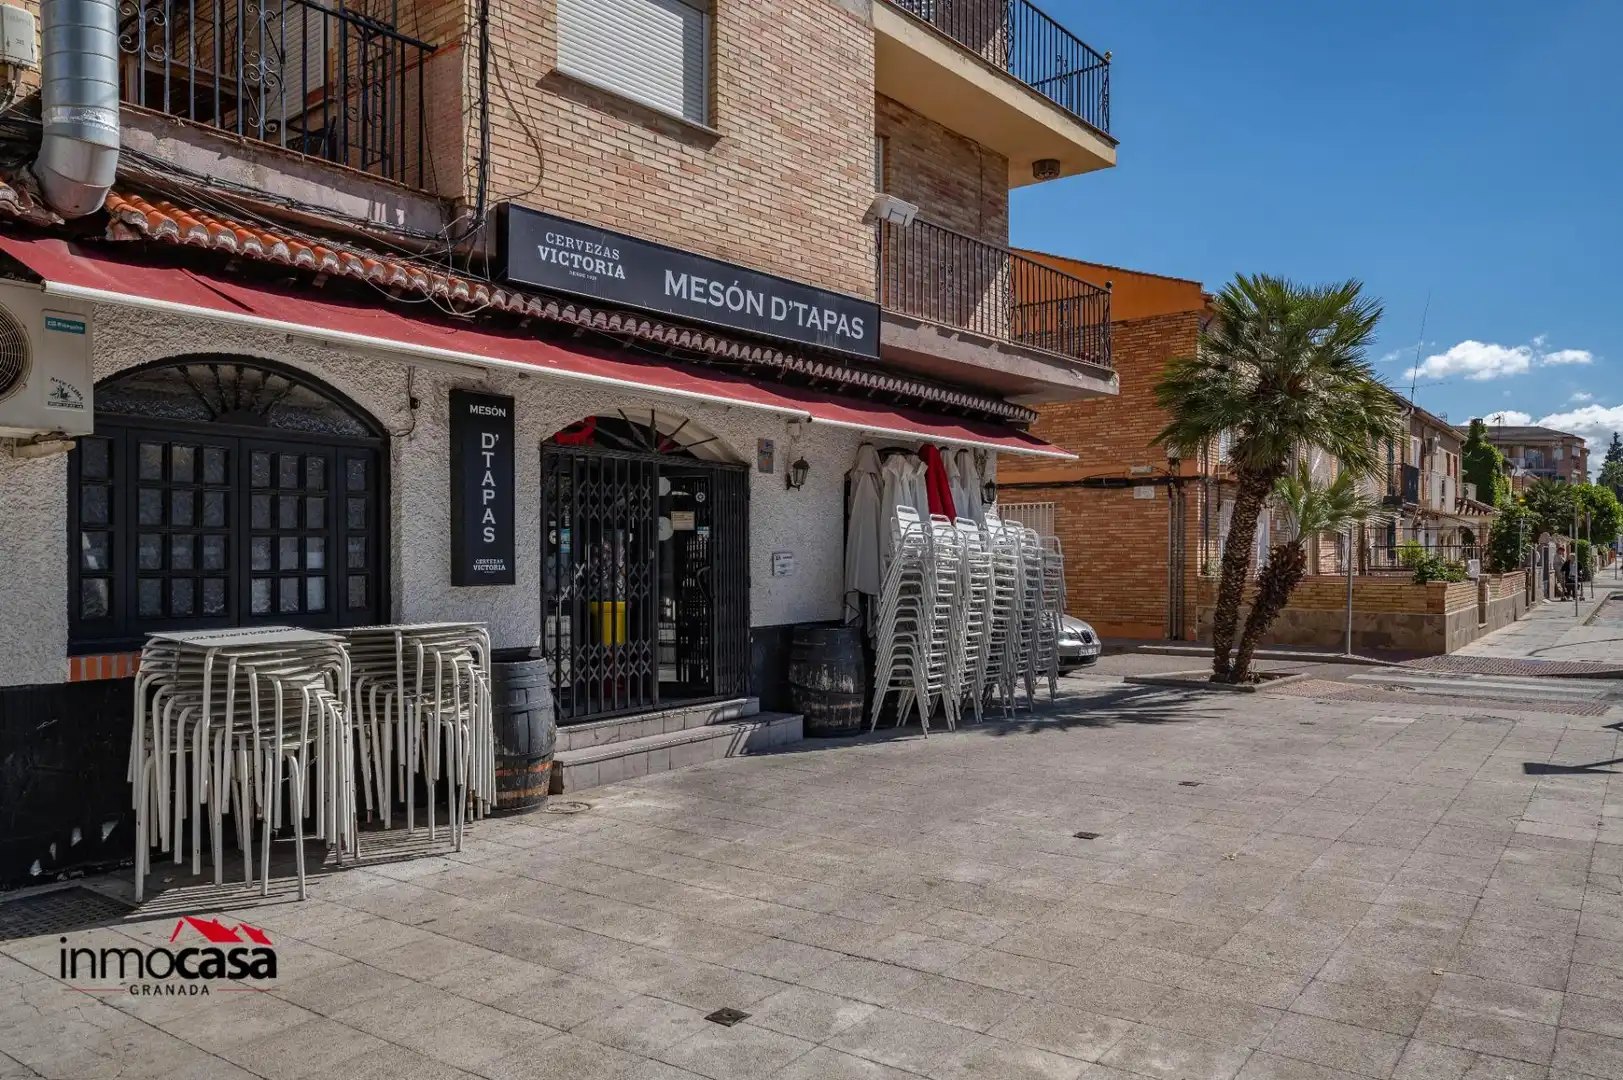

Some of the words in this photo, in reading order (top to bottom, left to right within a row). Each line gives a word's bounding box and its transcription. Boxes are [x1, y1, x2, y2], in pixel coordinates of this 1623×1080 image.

[545, 232, 620, 260] CERVEZAS
[537, 245, 626, 280] VICTORIA
[664, 269, 763, 317] MESÓN
[770, 297, 864, 340] D'TAPAS
[469, 404, 506, 417] MESÓN
